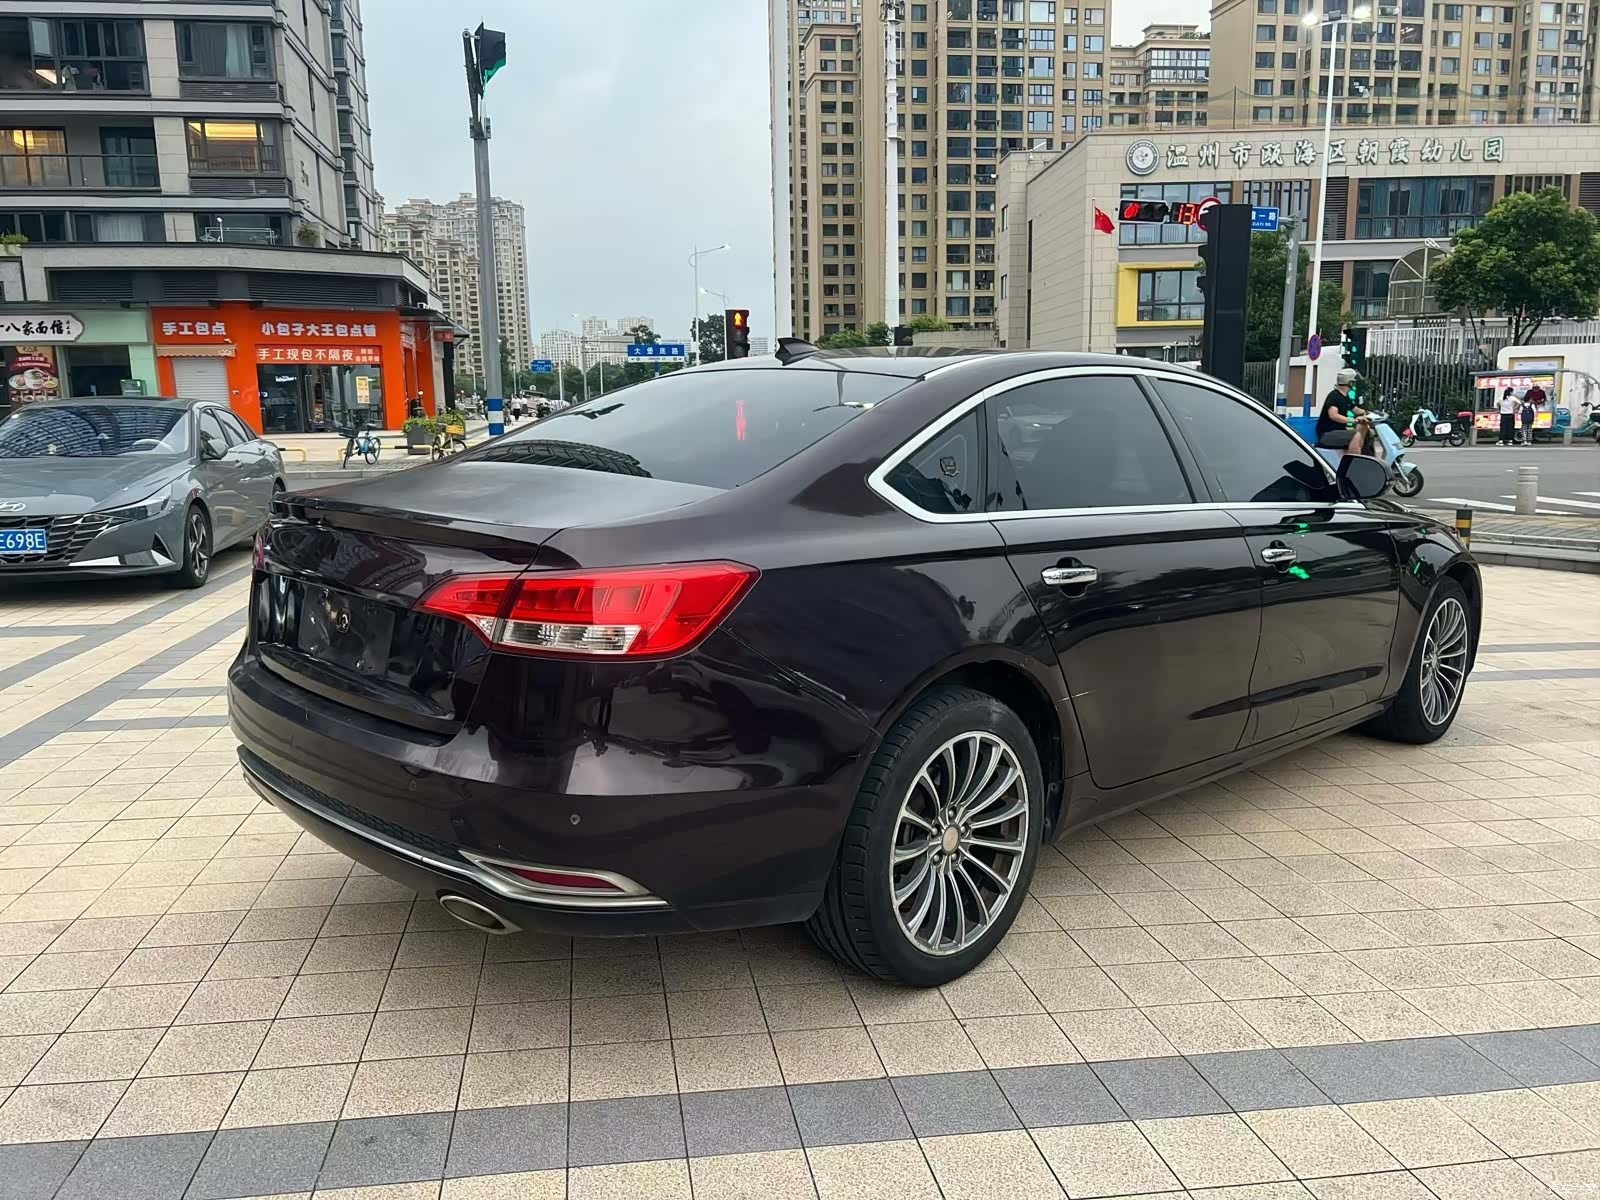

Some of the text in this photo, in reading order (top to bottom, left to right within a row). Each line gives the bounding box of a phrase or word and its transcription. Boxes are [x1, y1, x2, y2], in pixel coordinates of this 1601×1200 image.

[1166, 136, 1504, 169] 温州市瓯海区朝霞幼儿园
[1178, 203, 1195, 225] 13
[162, 321, 226, 336] 手工包点
[261, 322, 376, 337] 小包子大王包点铺
[258, 348, 353, 361] 手工现包不隔夜
